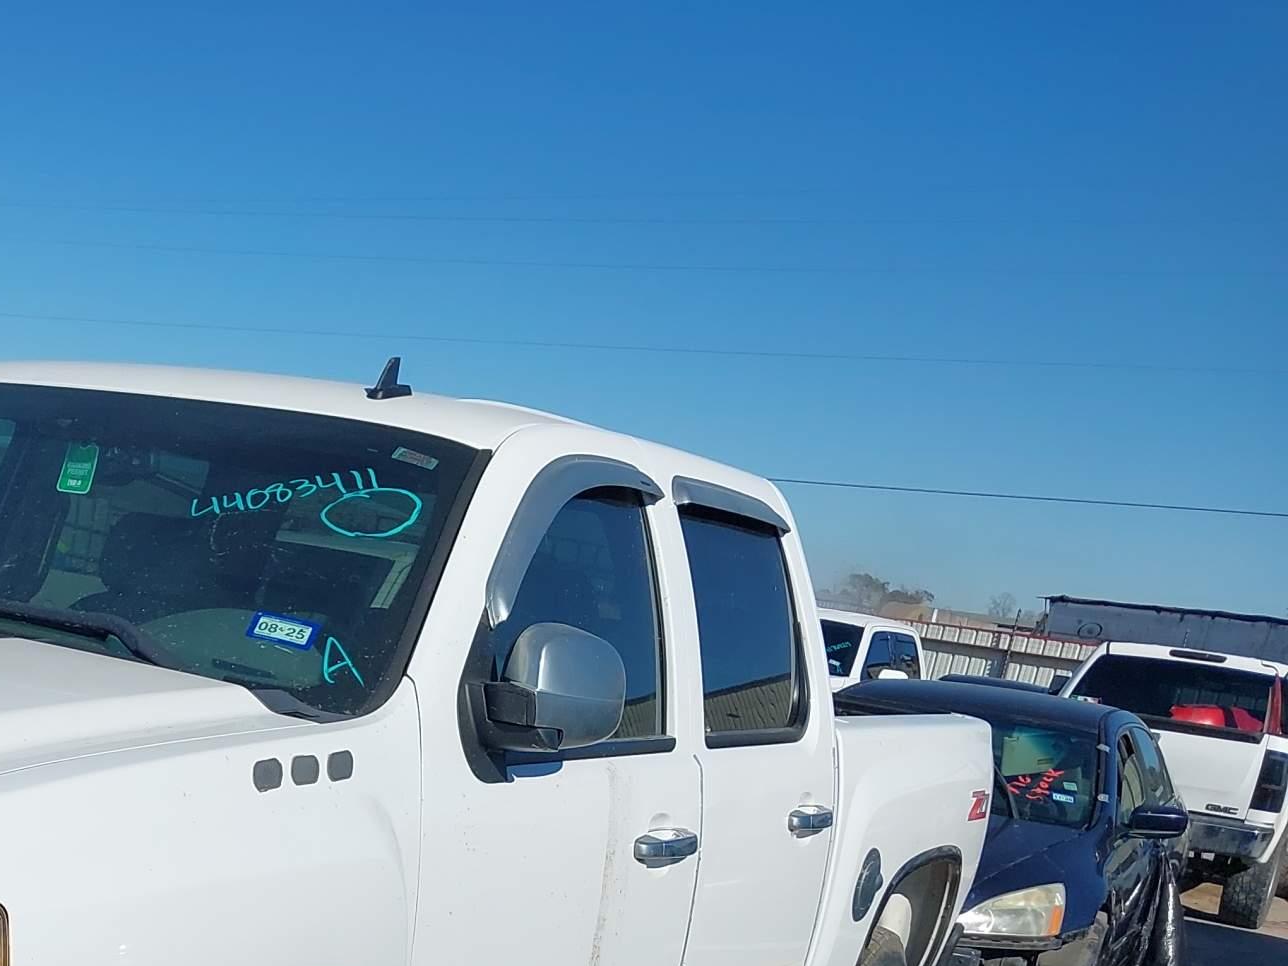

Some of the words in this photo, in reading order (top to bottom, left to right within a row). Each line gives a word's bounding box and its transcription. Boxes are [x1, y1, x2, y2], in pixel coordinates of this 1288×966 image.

[192, 468, 378, 516] 44083411
[323, 636, 365, 688] A
[1205, 803, 1239, 815] GMC
